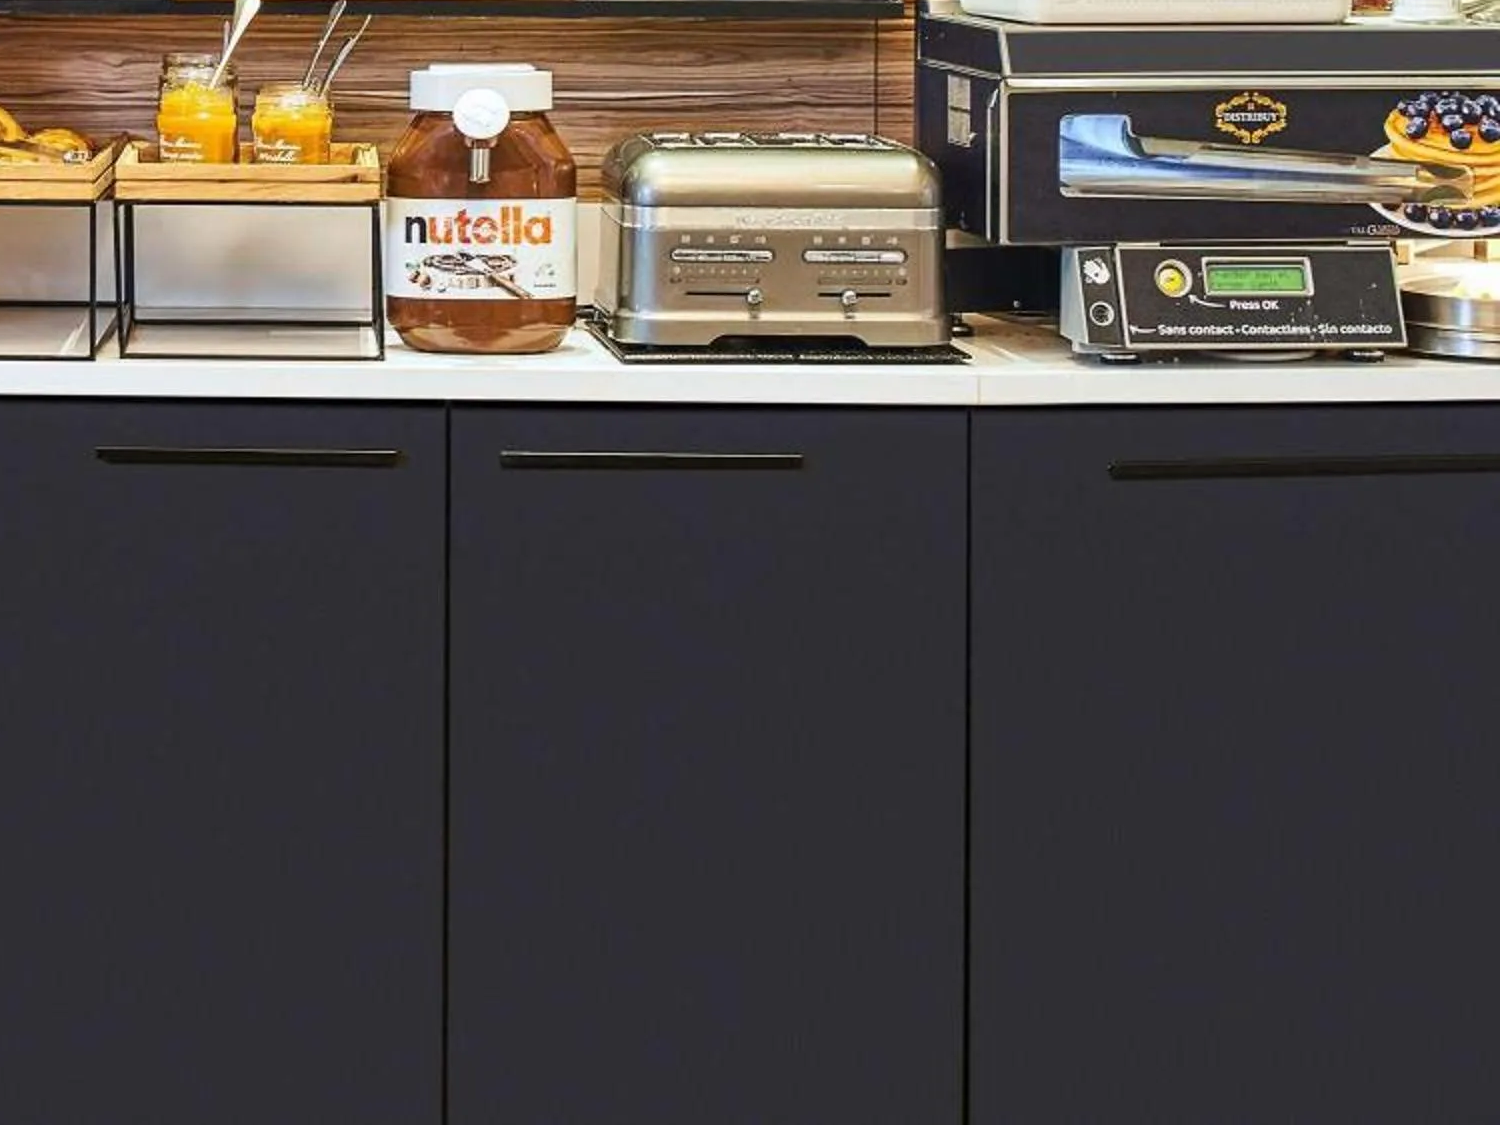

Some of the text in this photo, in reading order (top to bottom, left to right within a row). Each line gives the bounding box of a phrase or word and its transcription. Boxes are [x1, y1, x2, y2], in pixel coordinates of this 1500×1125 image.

[1223, 112, 1277, 122] DISTRIBUY
[404, 205, 553, 246] nutella
[1229, 299, 1280, 311] Press OK
[1157, 323, 1393, 337] Sans contact Contactless Sin contacto
